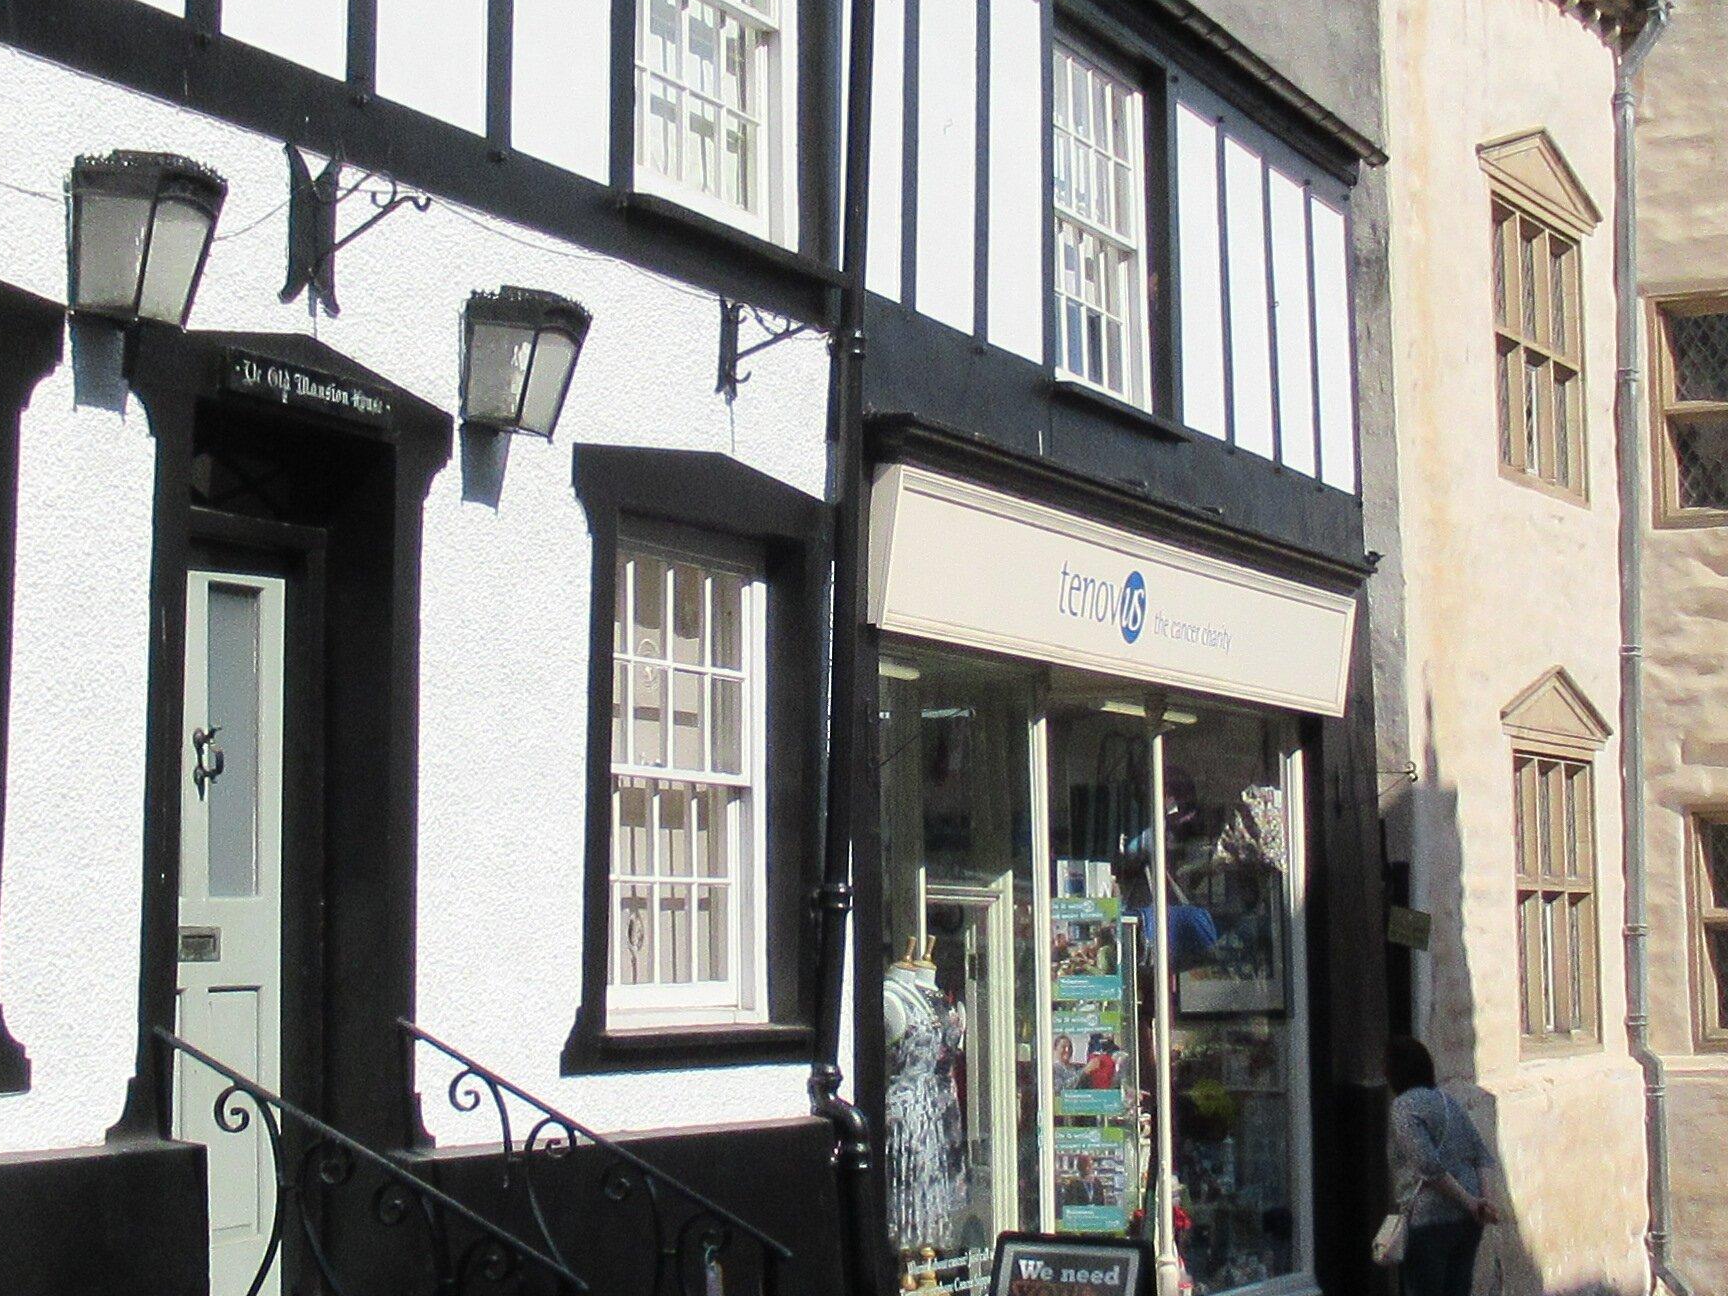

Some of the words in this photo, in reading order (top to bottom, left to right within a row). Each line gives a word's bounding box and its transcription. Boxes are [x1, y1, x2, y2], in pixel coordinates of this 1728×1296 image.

[294, 373, 349, 405] Mansion
[351, 389, 384, 415] House
[1058, 560, 1146, 638] tenovus
[1154, 609, 1169, 637] the
[1170, 617, 1201, 644] cancer
[1201, 622, 1232, 654] charity
[1018, 1258, 1053, 1281] We
[1060, 1264, 1121, 1286] need
